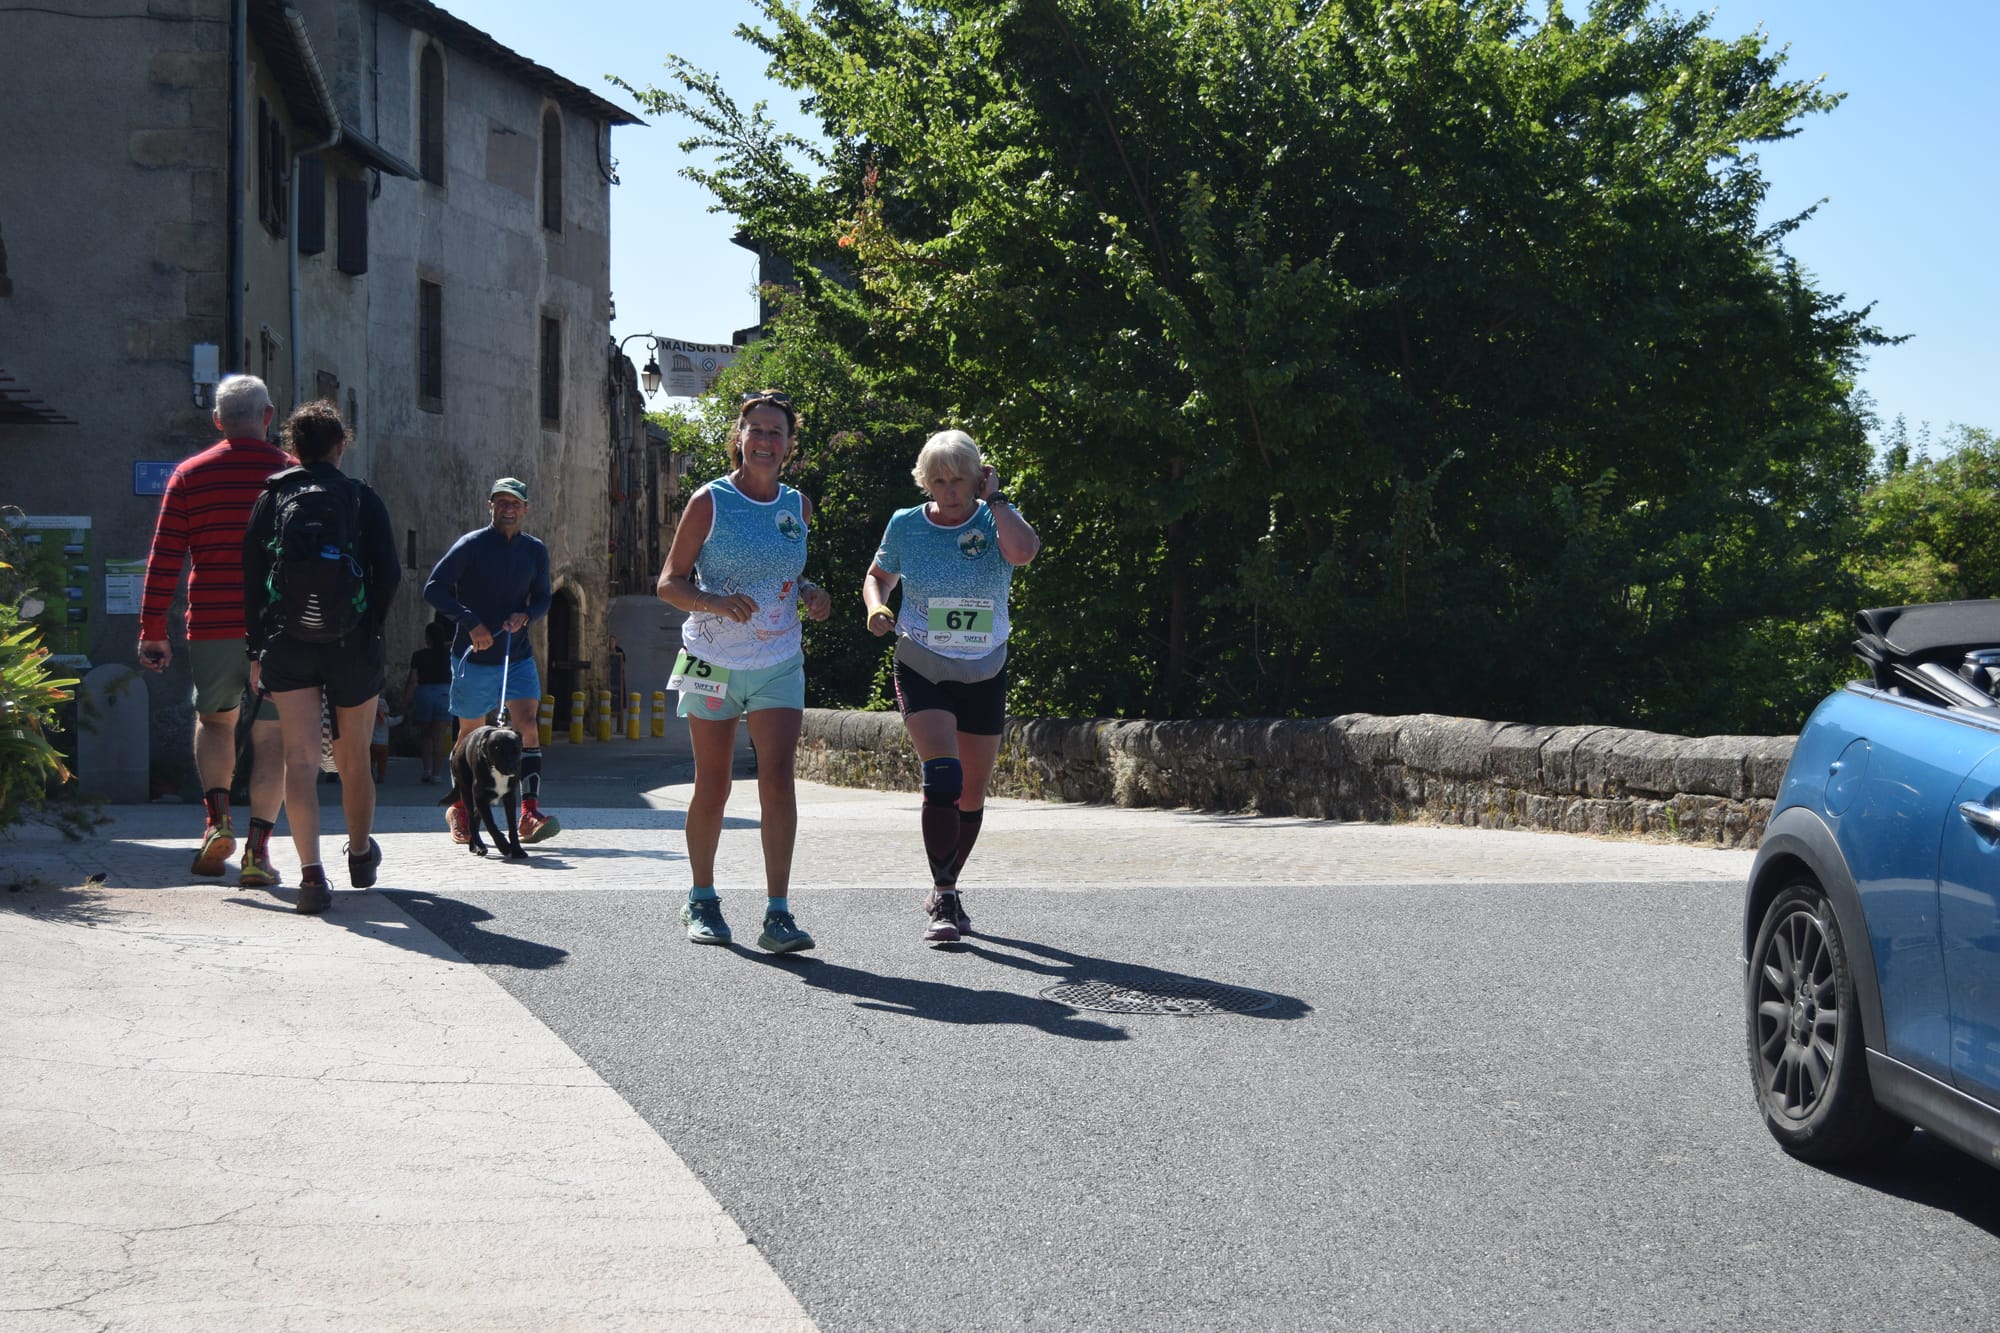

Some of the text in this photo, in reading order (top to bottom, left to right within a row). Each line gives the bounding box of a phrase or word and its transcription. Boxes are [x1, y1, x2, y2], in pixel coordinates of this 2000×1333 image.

[661, 340, 716, 352] MAISON
[946, 610, 978, 630] 67
[683, 655, 712, 678] 75
